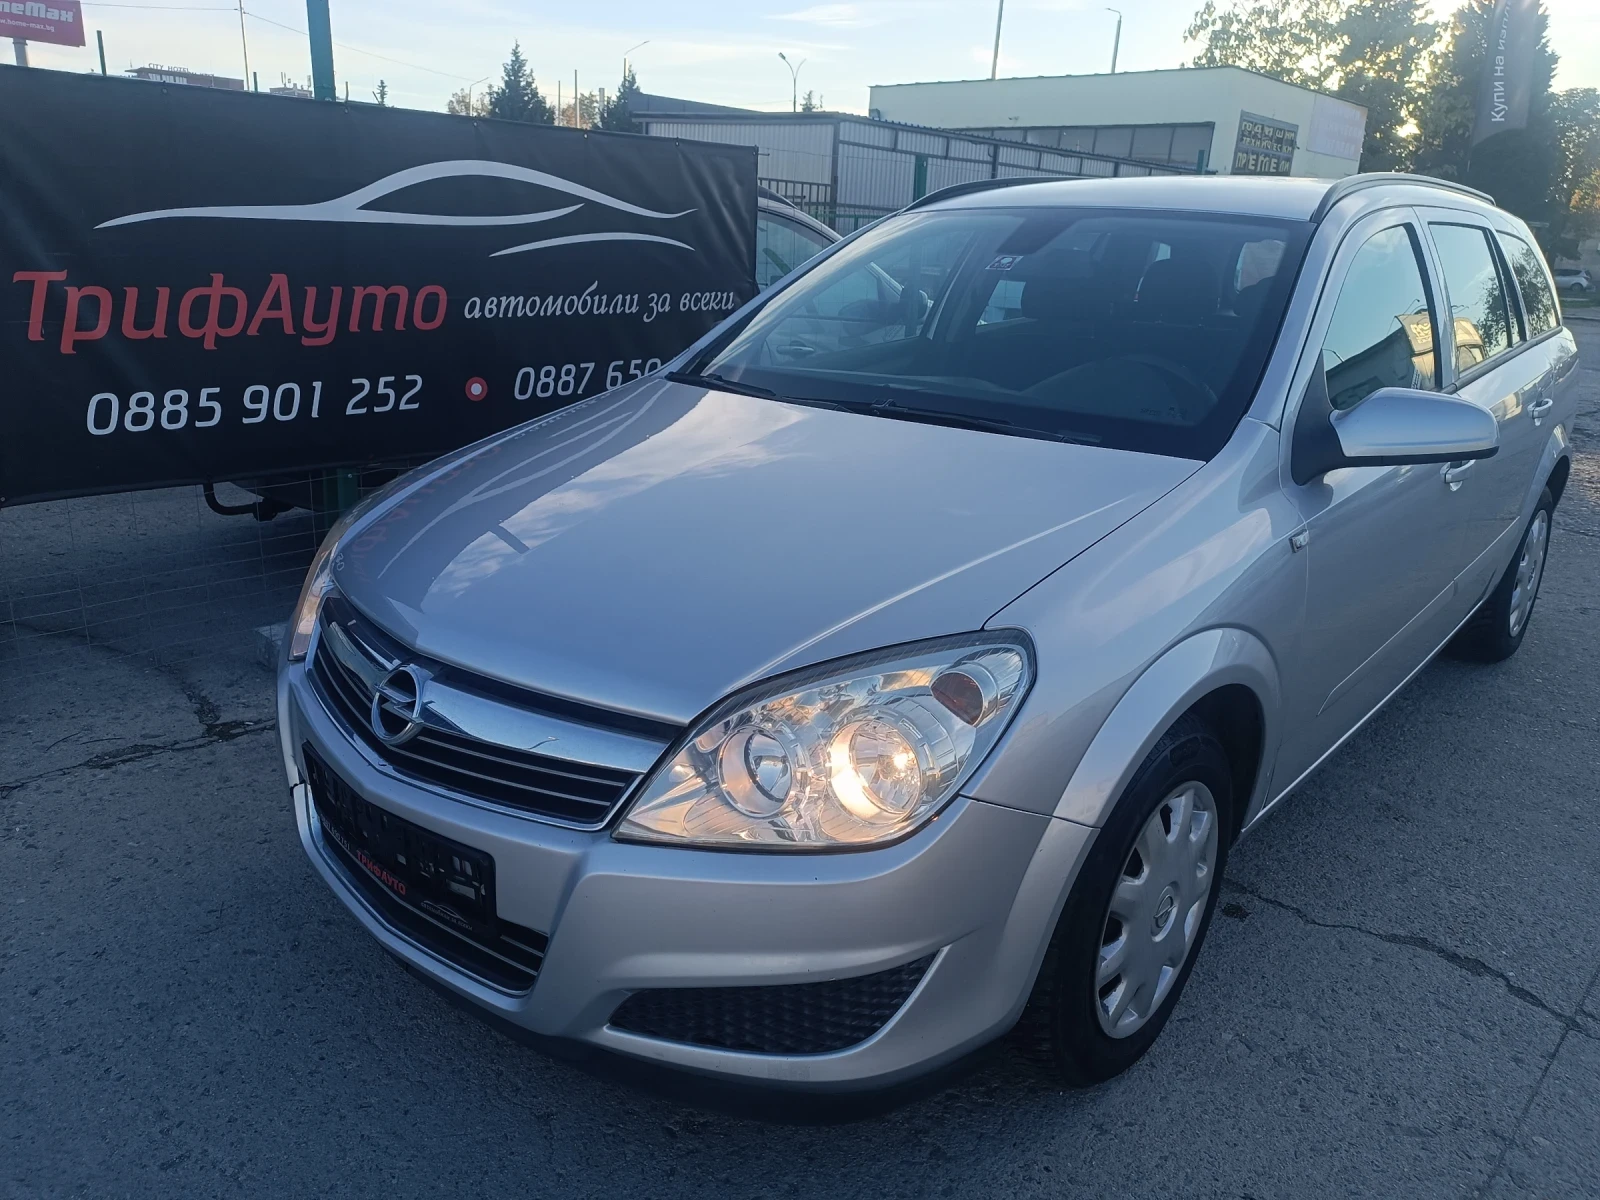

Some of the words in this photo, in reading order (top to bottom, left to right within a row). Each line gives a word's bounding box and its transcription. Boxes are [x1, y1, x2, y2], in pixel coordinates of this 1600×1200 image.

[148, 62, 164, 70] CITY
[167, 65, 189, 73] HOTEL
[1493, 55, 1505, 76] на
[1490, 81, 1508, 122] Купи
[12, 269, 448, 354] ТрифАуто
[464, 280, 639, 319] автомобили
[643, 292, 671, 322] за
[679, 291, 735, 312] всеки
[514, 362, 595, 400] 0887
[86, 387, 222, 436] 0885
[242, 380, 322, 424] 901
[345, 374, 423, 415] 252
[356, 850, 406, 895] ТРИФАУТО
